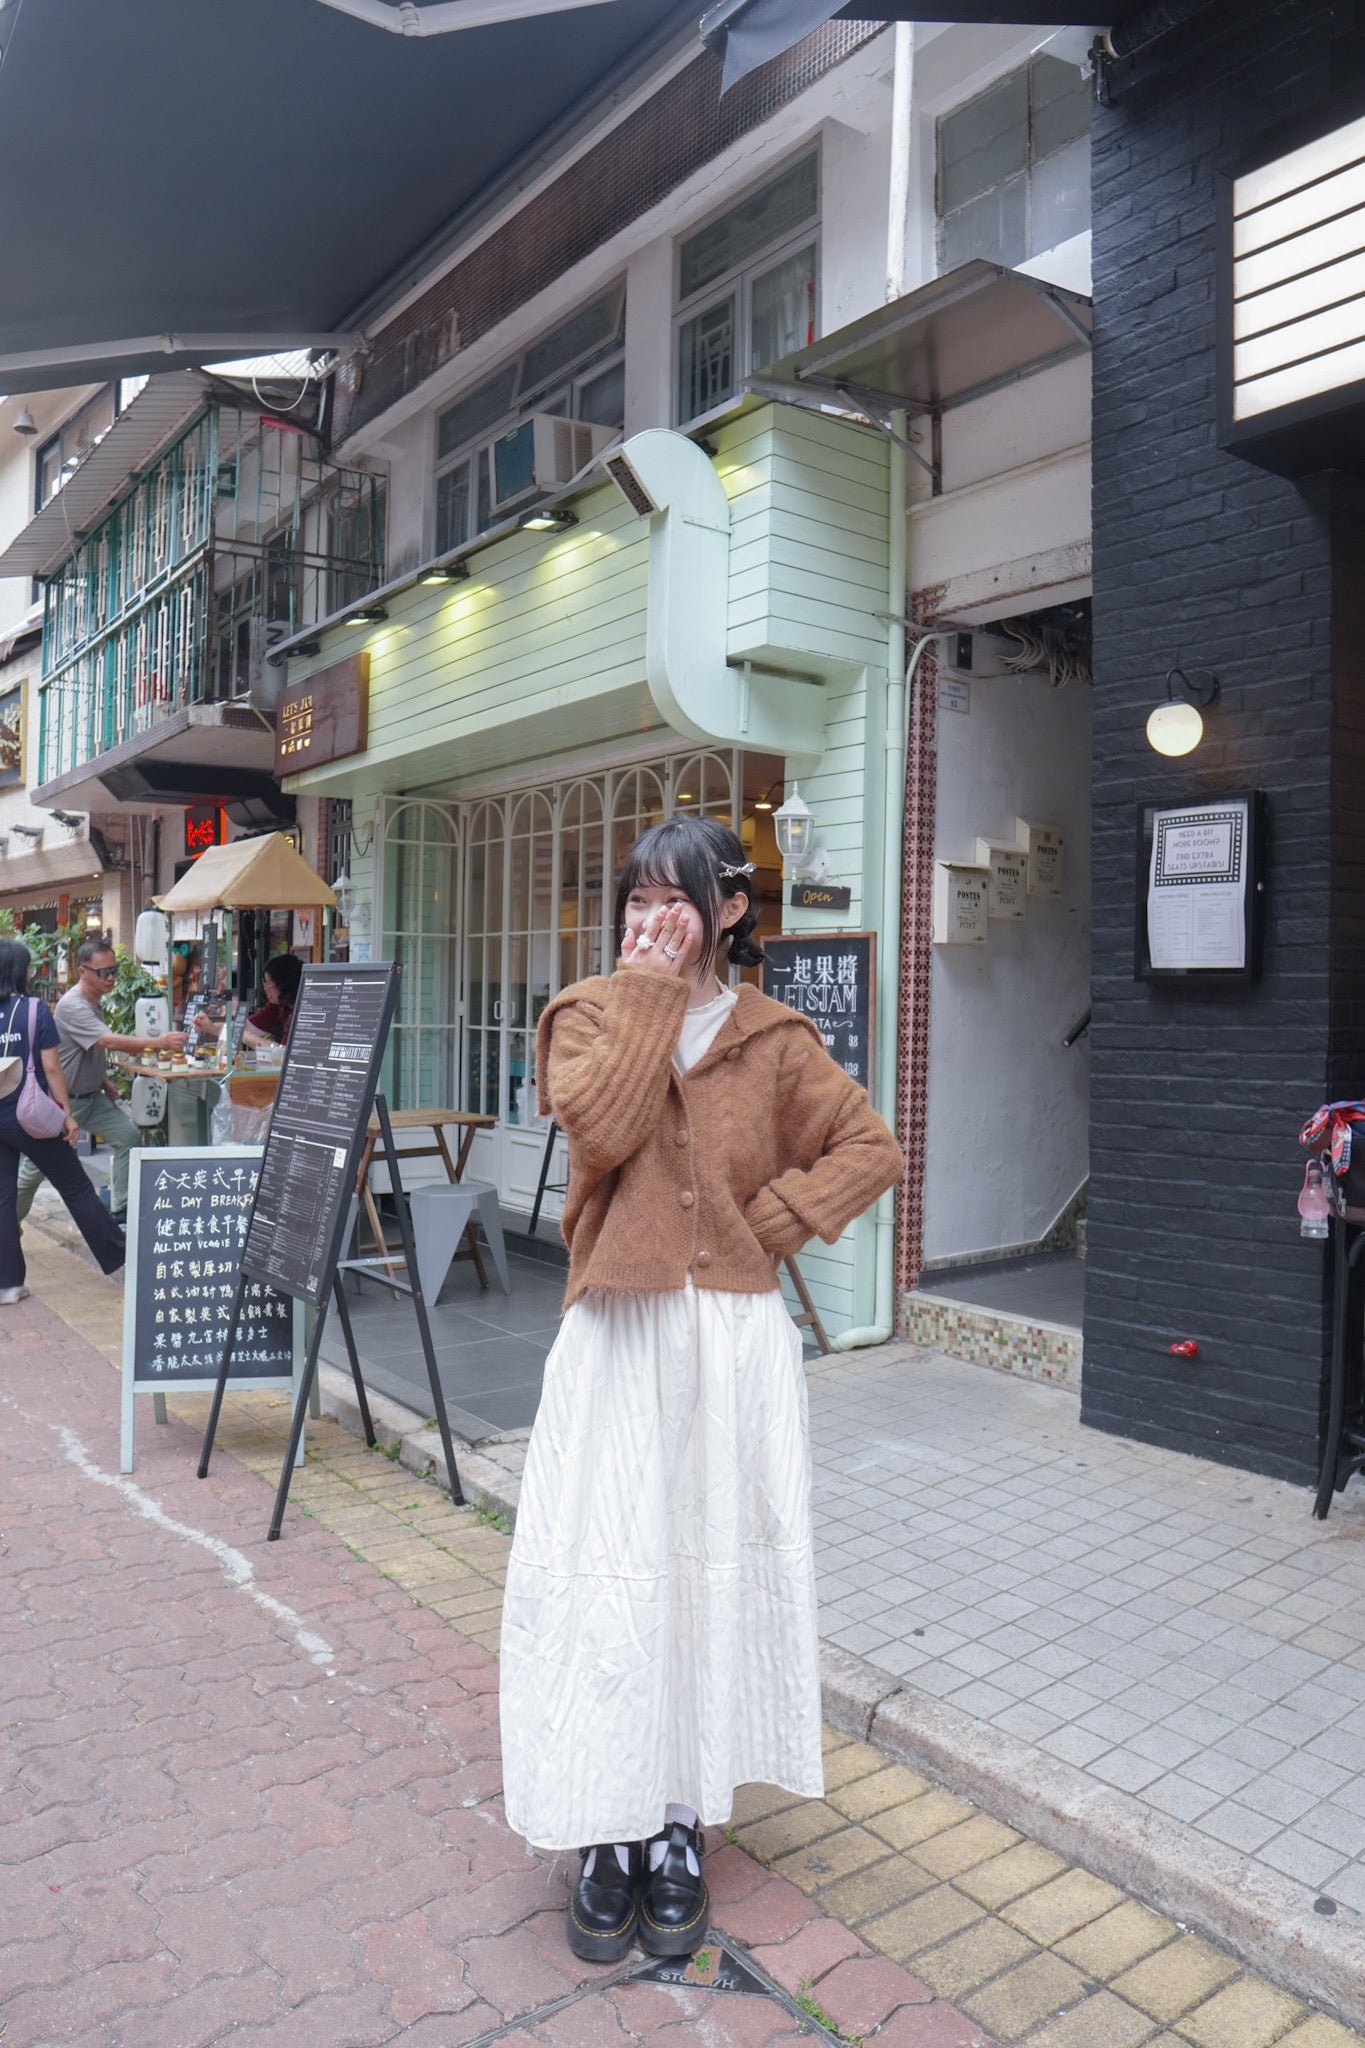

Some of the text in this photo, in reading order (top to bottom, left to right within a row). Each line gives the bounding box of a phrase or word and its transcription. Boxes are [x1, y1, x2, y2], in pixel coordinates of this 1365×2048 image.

[300, 695, 313, 710] JAM
[803, 890, 834, 905] Open
[957, 890, 980, 900] POSTES
[959, 921, 976, 930] POST
[773, 953, 858, 984] 一起果醬
[153, 1197, 173, 1211] ALL
[181, 1195, 203, 1208] DAY
[153, 1241, 171, 1254] ALL
[173, 1240, 192, 1251] DAY
[155, 1260, 240, 1280] 自家製厚切
